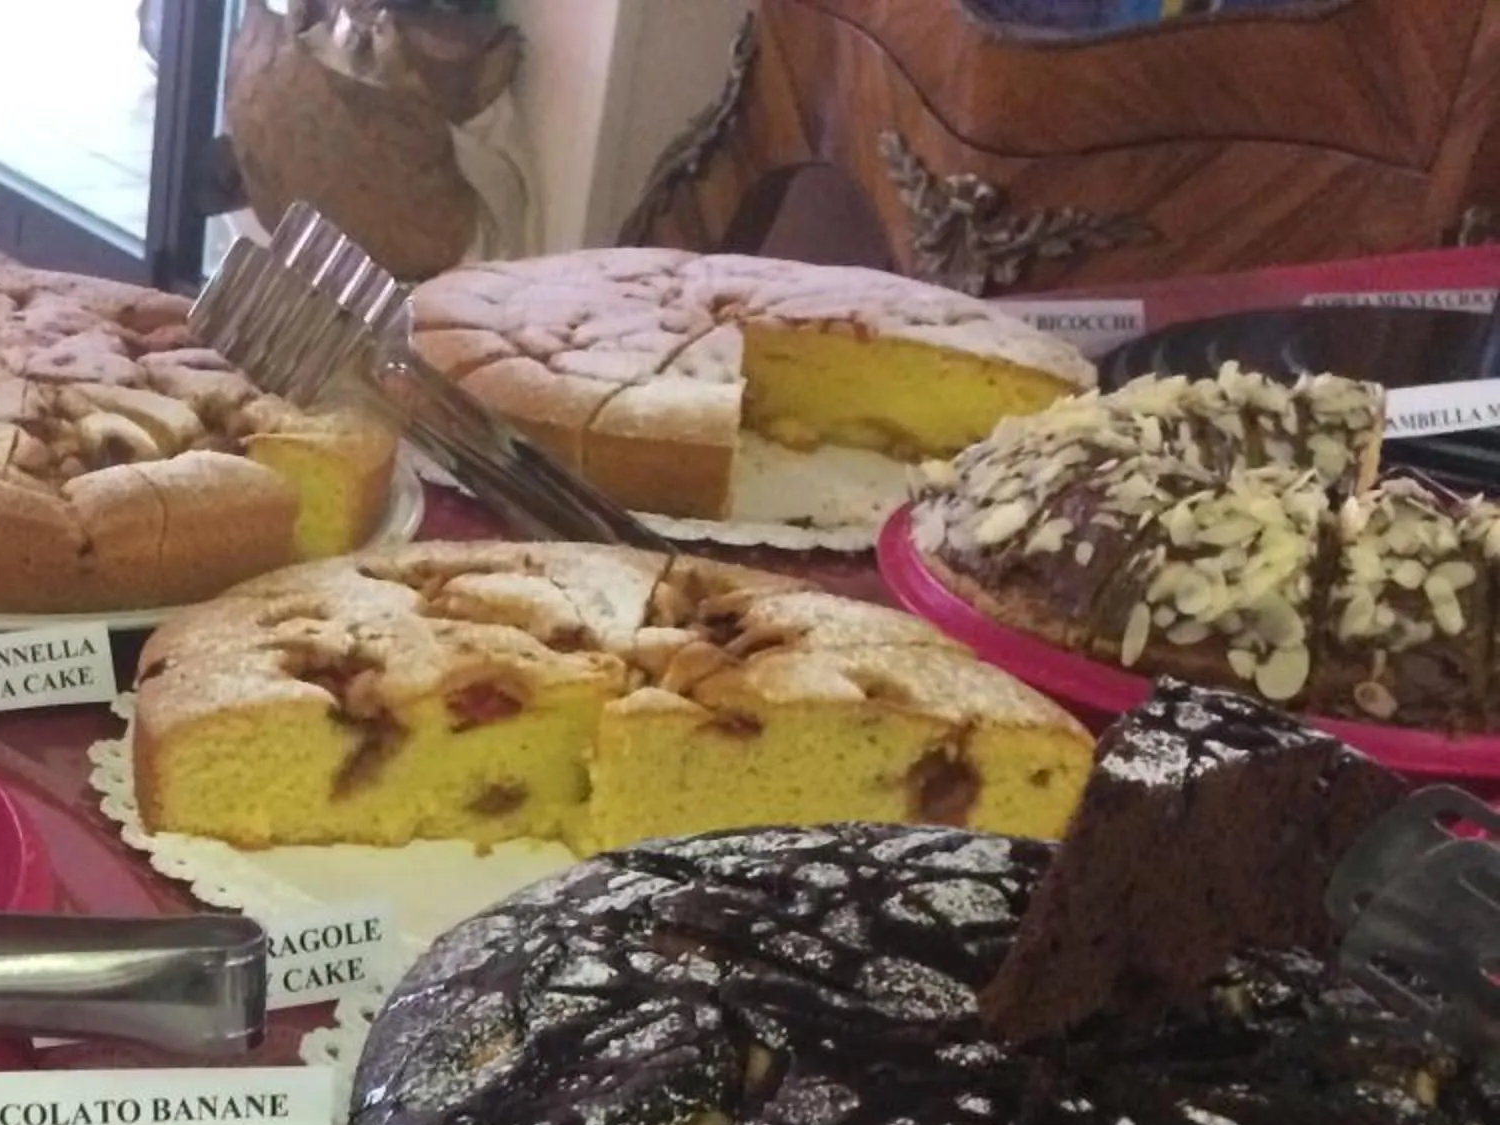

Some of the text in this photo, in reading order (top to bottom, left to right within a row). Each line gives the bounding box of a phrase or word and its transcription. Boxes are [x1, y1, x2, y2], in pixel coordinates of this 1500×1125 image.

[23, 666, 93, 694] CAKE
[282, 957, 365, 993] CAKE
[152, 1093, 289, 1124] BANANE
